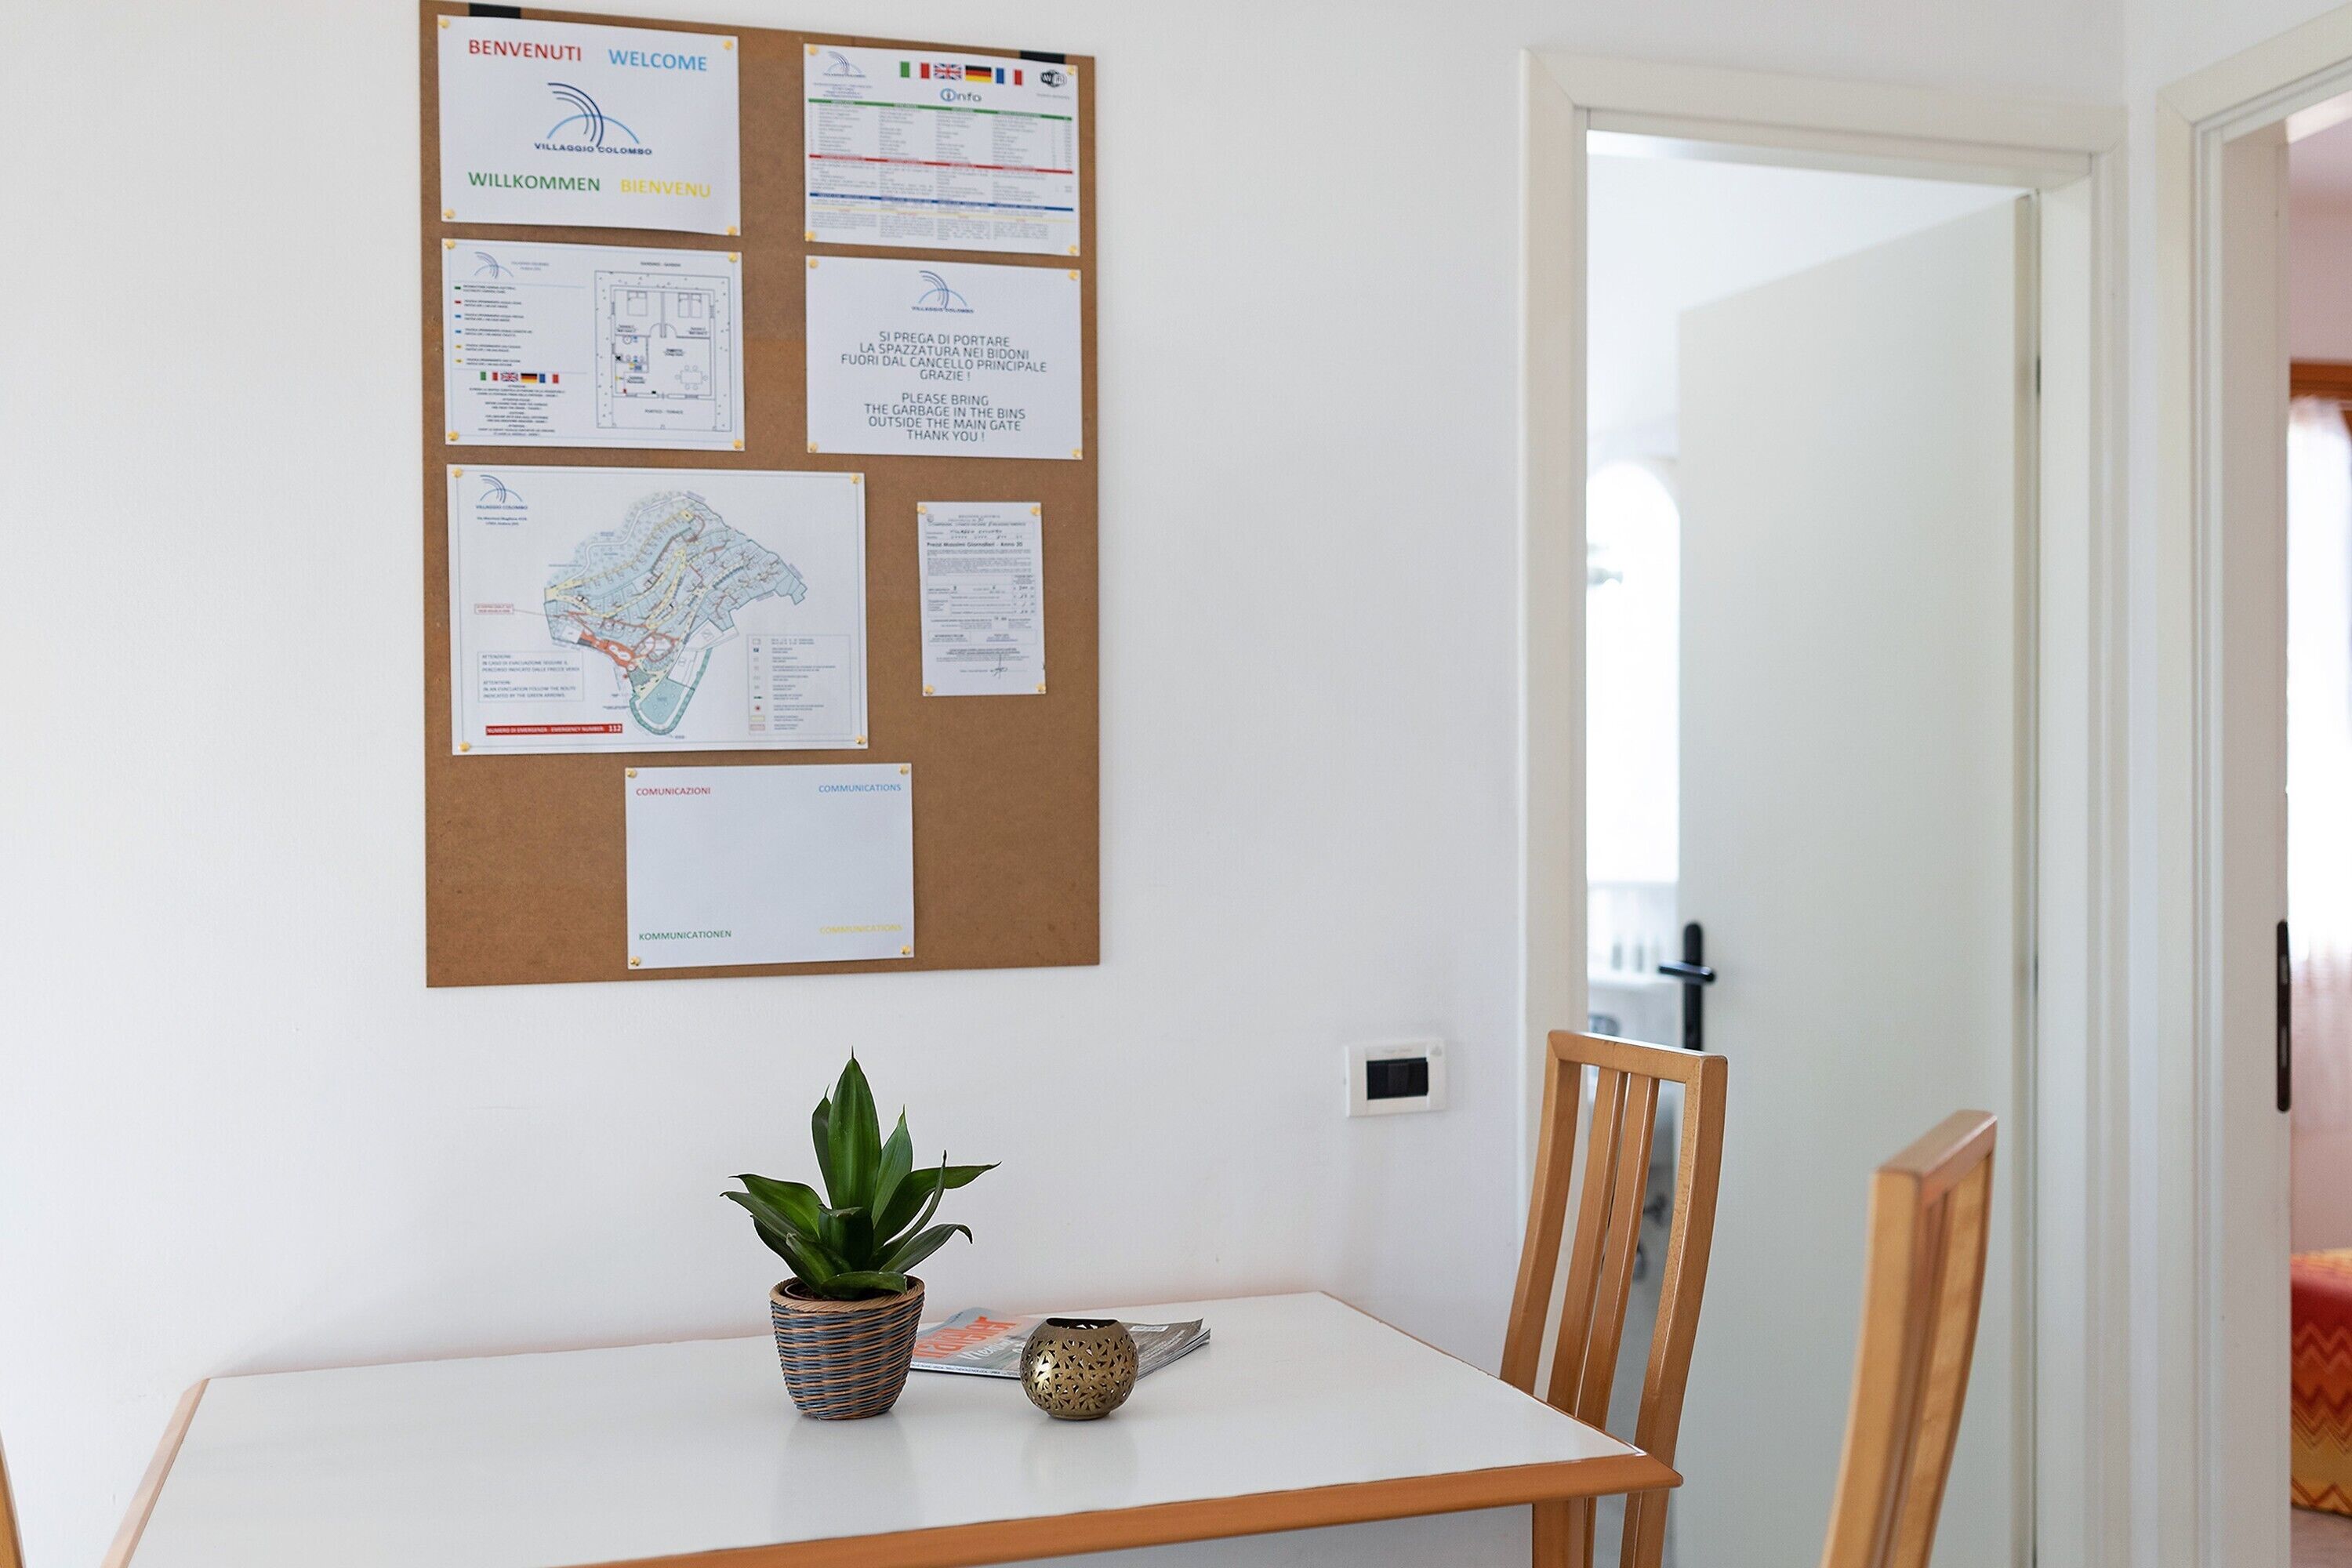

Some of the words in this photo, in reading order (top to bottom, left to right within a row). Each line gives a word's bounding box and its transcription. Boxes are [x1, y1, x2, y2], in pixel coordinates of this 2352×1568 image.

[469, 39, 582, 61] BENVENUTI
[608, 49, 707, 71] WELCOME
[534, 141, 596, 154] VILLAGGIO
[597, 144, 653, 156] COLOMBO
[468, 172, 601, 191] WILLKOMMEN
[620, 179, 711, 198] BIENVENU
[879, 330, 891, 343] SI
[893, 331, 935, 344] PREGA
[937, 333, 951, 345] DI
[953, 335, 1011, 347] PORTARE
[859, 341, 876, 354] LA
[878, 343, 961, 358] SPAZZATURA
[963, 347, 985, 358] NEI
[987, 347, 1030, 360] BIDONI
[840, 353, 880, 366] FUORI
[882, 354, 908, 367] DAL
[909, 356, 975, 370] CANCELLO
[976, 358, 1047, 373] PRINCIPALE
[919, 368, 964, 381] GRAZIE
[901, 391, 948, 405] PLEASE
[950, 394, 989, 406] BRING
[864, 402, 889, 415] THE
[891, 404, 950, 417] GARBAGE
[953, 407, 967, 417] IN
[970, 407, 996, 419] THE
[996, 408, 1026, 419] BINS
[868, 416, 923, 428] OUTSIDE
[926, 417, 950, 429] THE
[953, 419, 987, 430] MAIN
[989, 419, 1022, 431] GATE
[906, 429, 949, 441] THANK
[952, 430, 979, 442] YOU
[818, 784, 902, 793] COMMUNICATIONS
[638, 930, 731, 941] KOMMUNICATIONEN
